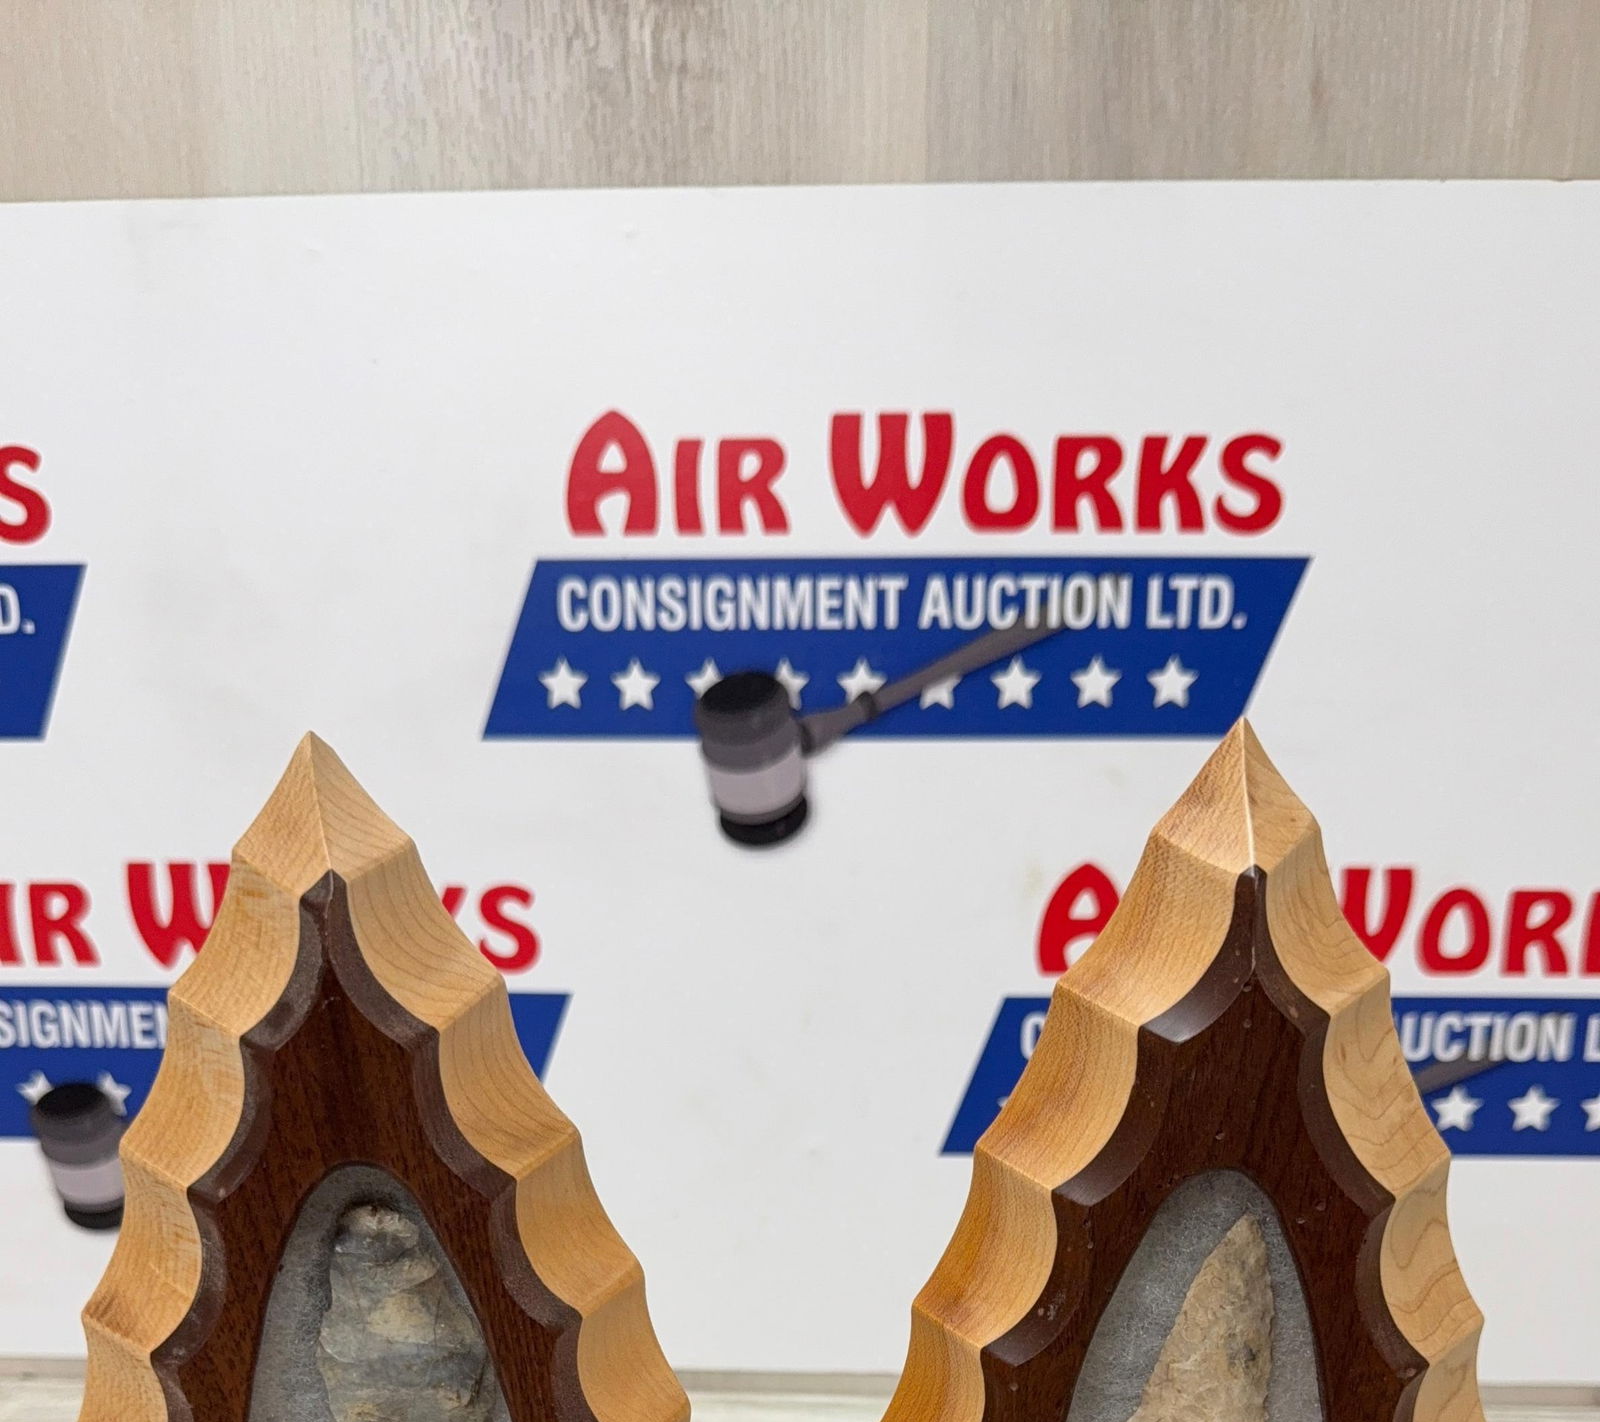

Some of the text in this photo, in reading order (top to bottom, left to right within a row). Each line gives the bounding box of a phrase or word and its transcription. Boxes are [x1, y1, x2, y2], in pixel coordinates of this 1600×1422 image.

[556, 572, 1247, 634] CONSIGNMENT AUCTION LTD.
[0, 880, 100, 968] IR
[1341, 864, 1600, 979] WOR
[1398, 1011, 1576, 1063] UCTION
